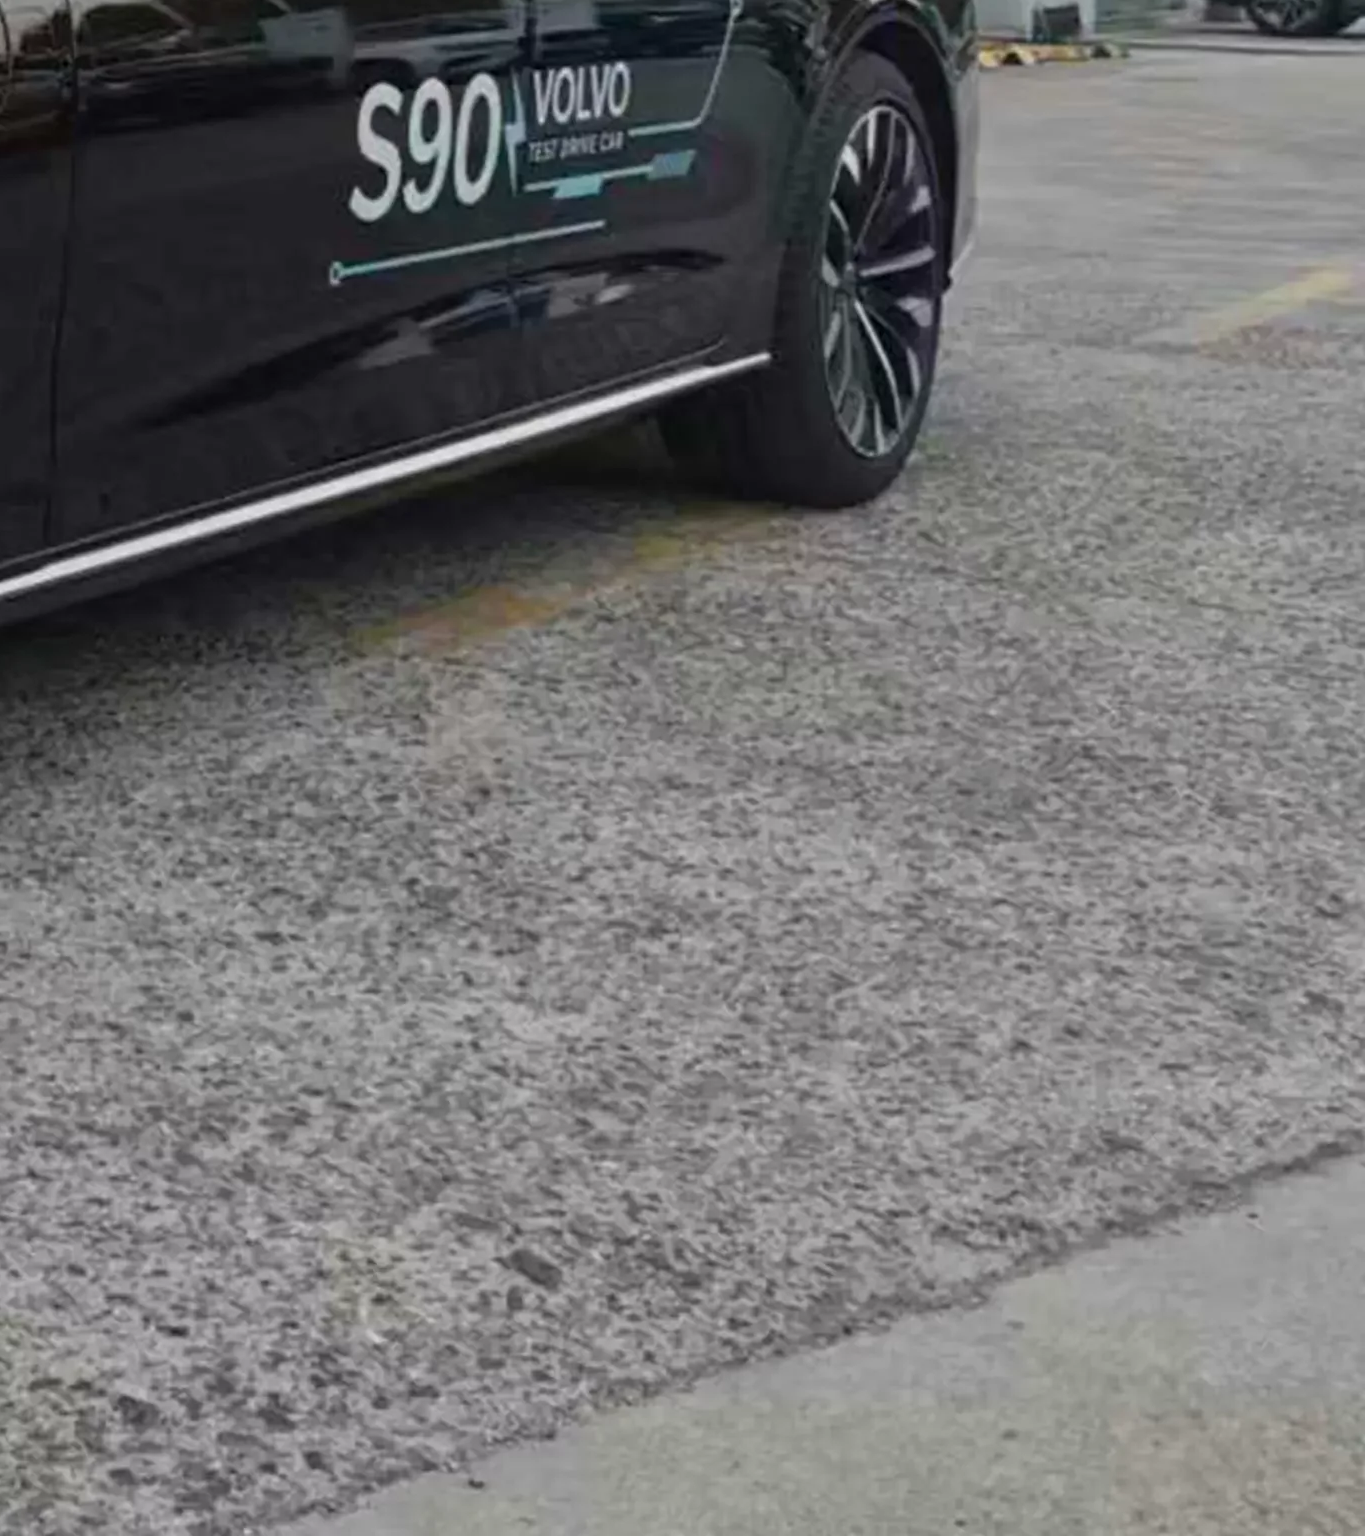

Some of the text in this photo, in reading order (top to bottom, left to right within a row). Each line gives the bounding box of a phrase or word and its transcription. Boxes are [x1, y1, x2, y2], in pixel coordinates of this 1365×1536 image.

[532, 61, 631, 125] VOLVO
[528, 130, 625, 163] TEST DRIVE CAR
